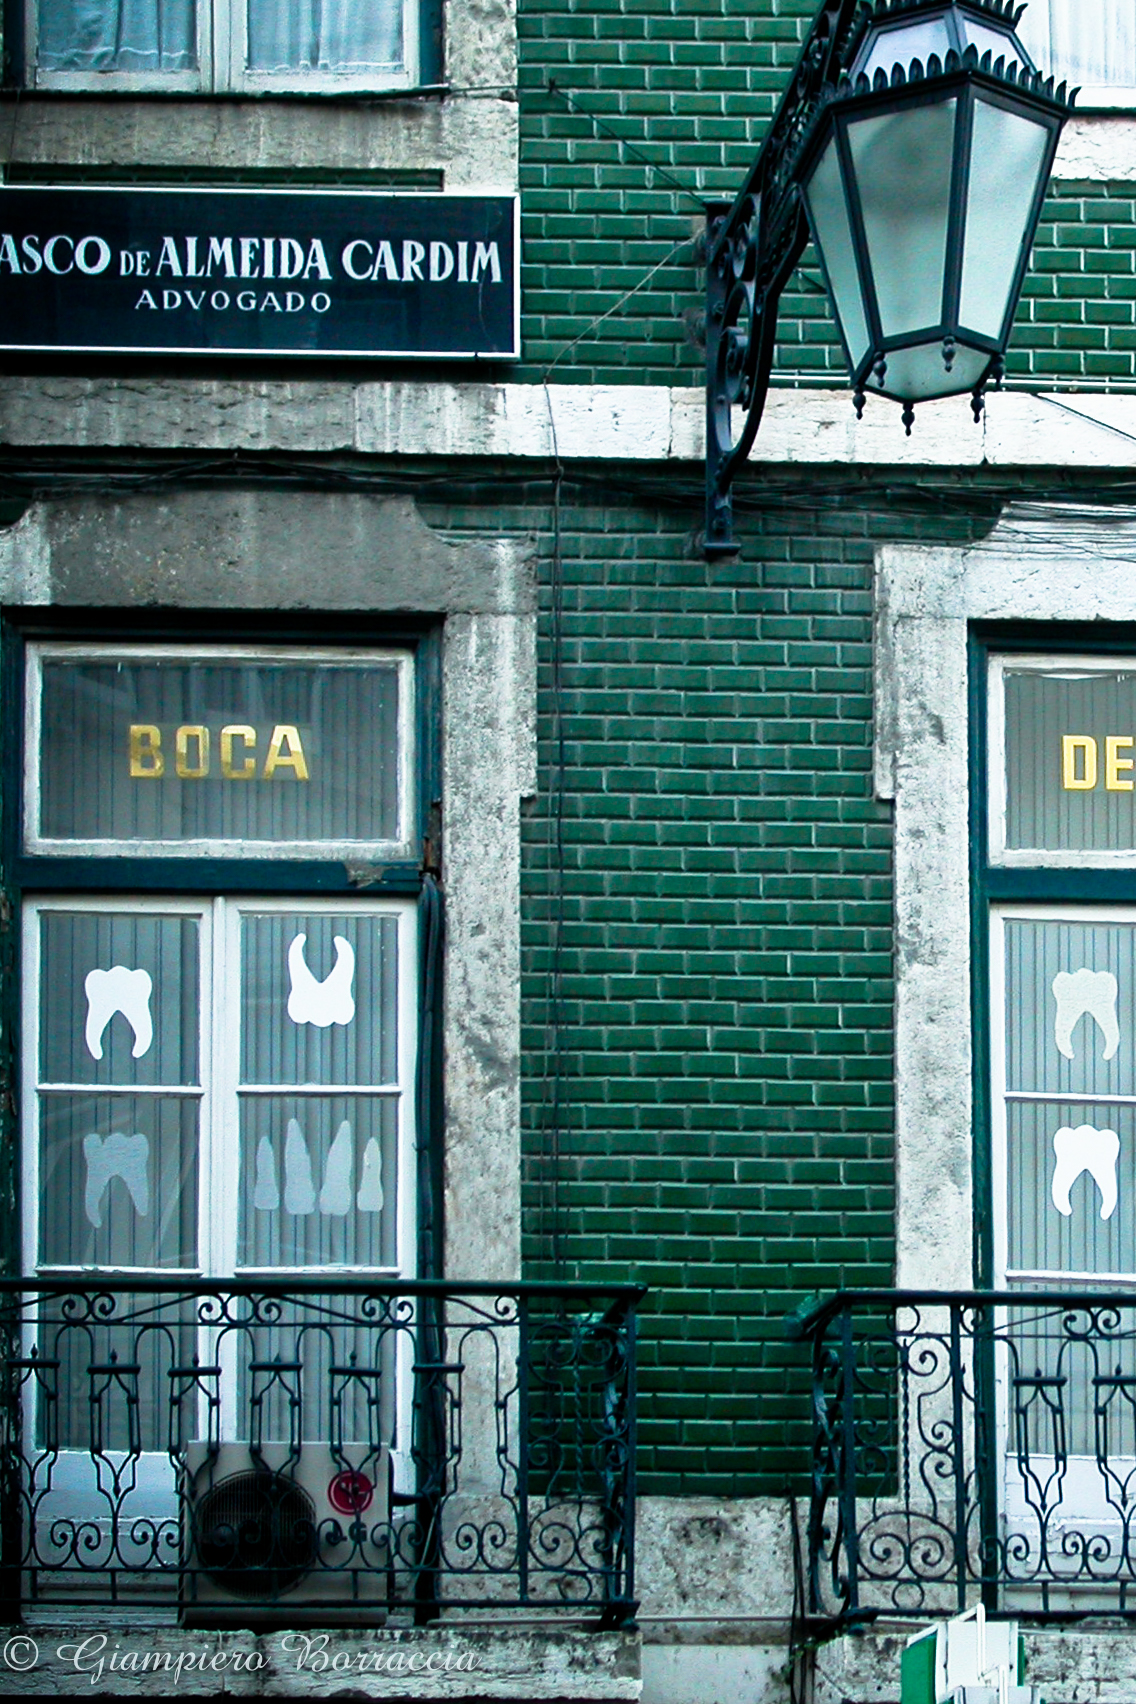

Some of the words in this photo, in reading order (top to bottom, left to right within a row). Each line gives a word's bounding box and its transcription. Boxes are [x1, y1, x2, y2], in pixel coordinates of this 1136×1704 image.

[119, 249, 151, 277] DE
[155, 236, 333, 280] ALMEIDA
[341, 240, 502, 283] CARDIM
[134, 289, 332, 313] ADVOGADO
[129, 724, 310, 780] BOCA
